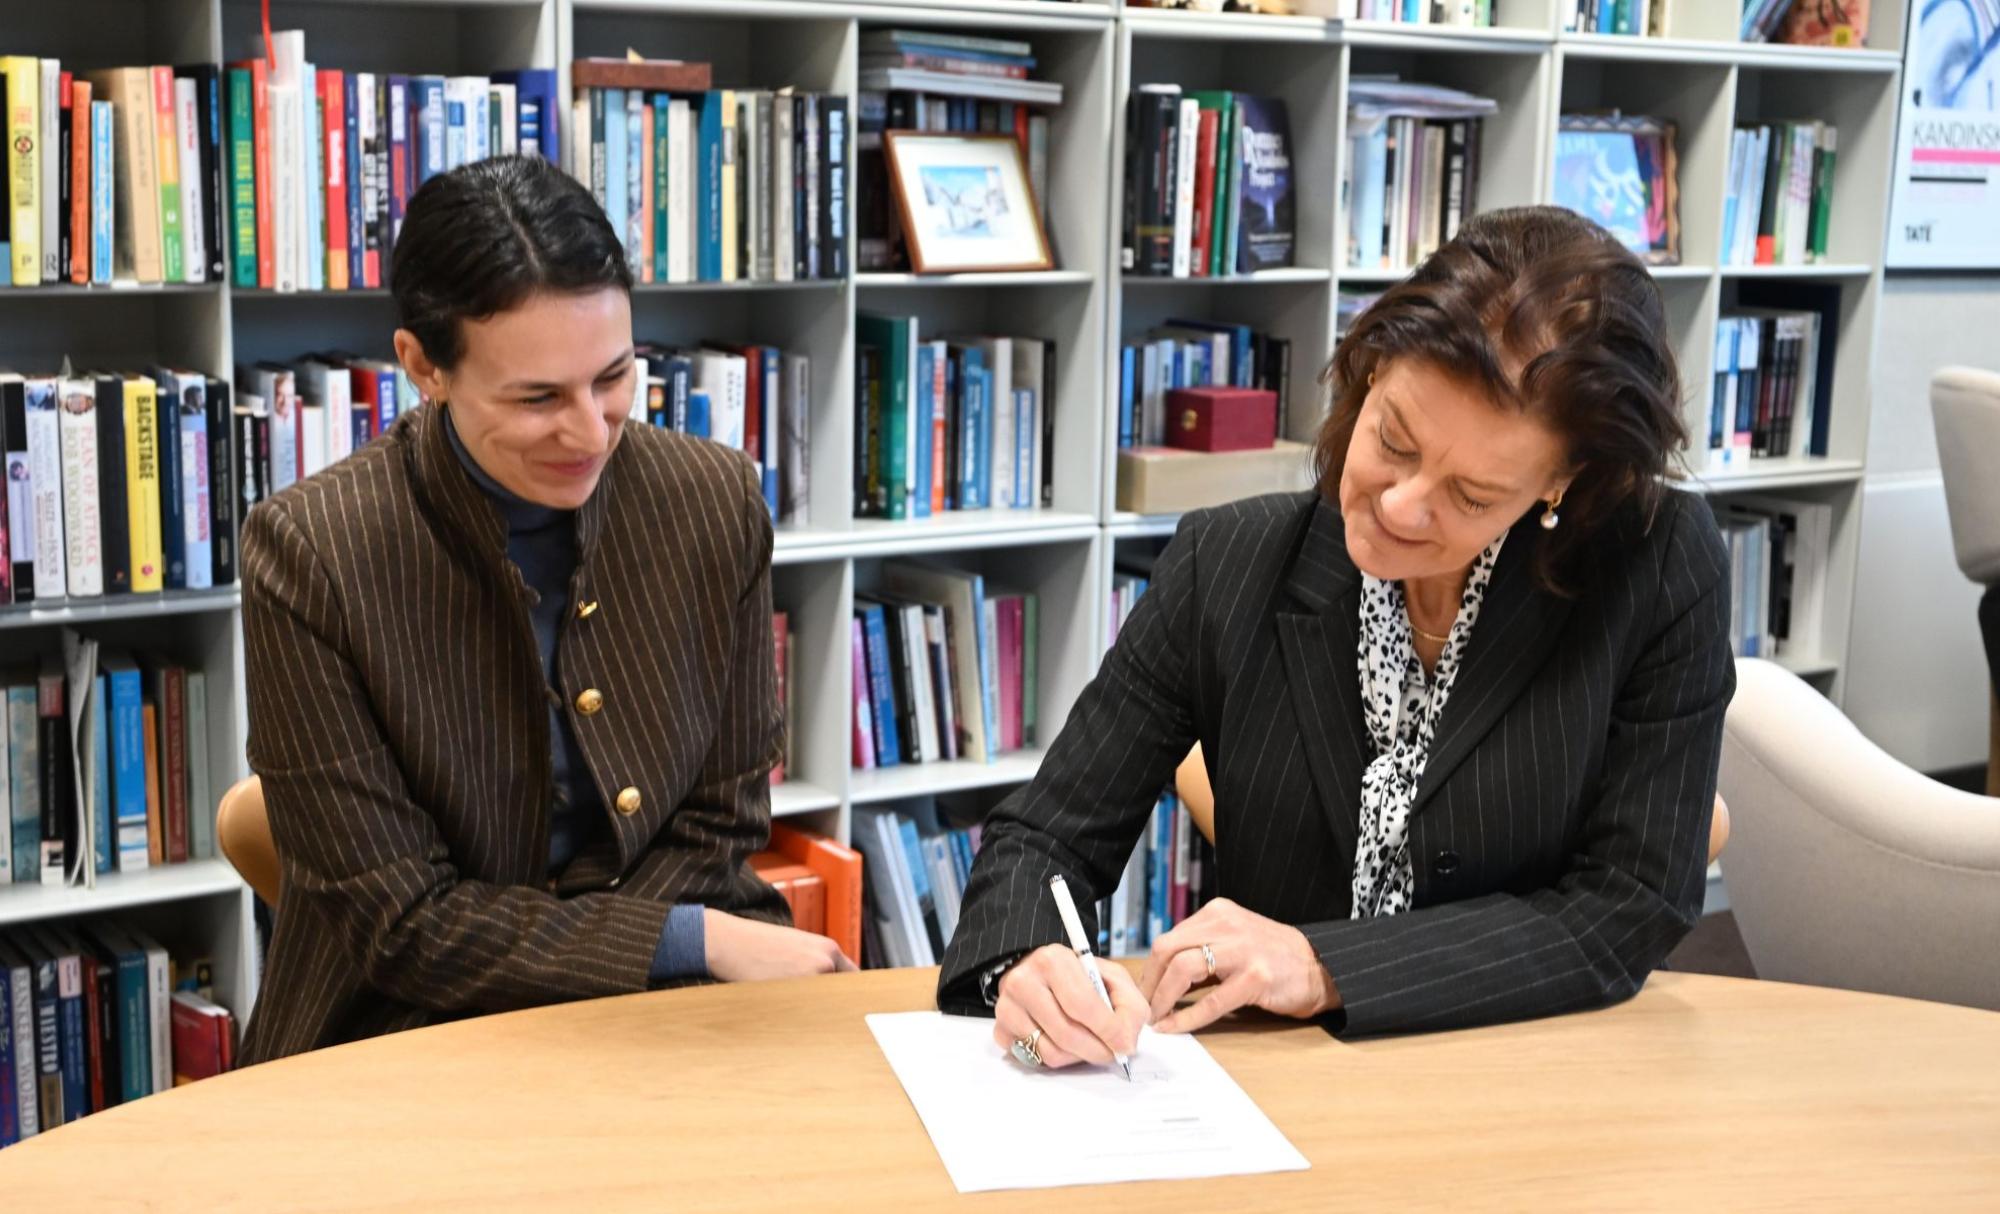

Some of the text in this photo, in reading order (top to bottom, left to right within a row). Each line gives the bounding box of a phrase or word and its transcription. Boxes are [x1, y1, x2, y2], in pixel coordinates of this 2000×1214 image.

[376, 151, 388, 214] TRUST
[350, 207, 360, 248] FUTURE
[1905, 225, 1931, 242] TATE
[136, 396, 154, 480] BACKSTAGE
[44, 490, 56, 523] SEIZE
[64, 426, 83, 567] BOB WOODWARD
[80, 426, 99, 567] PLAN OF ATTACK
[195, 431, 209, 542] GORDON BROWN
[47, 539, 59, 576] HOUR
[21, 1066, 36, 1129] WORLD
